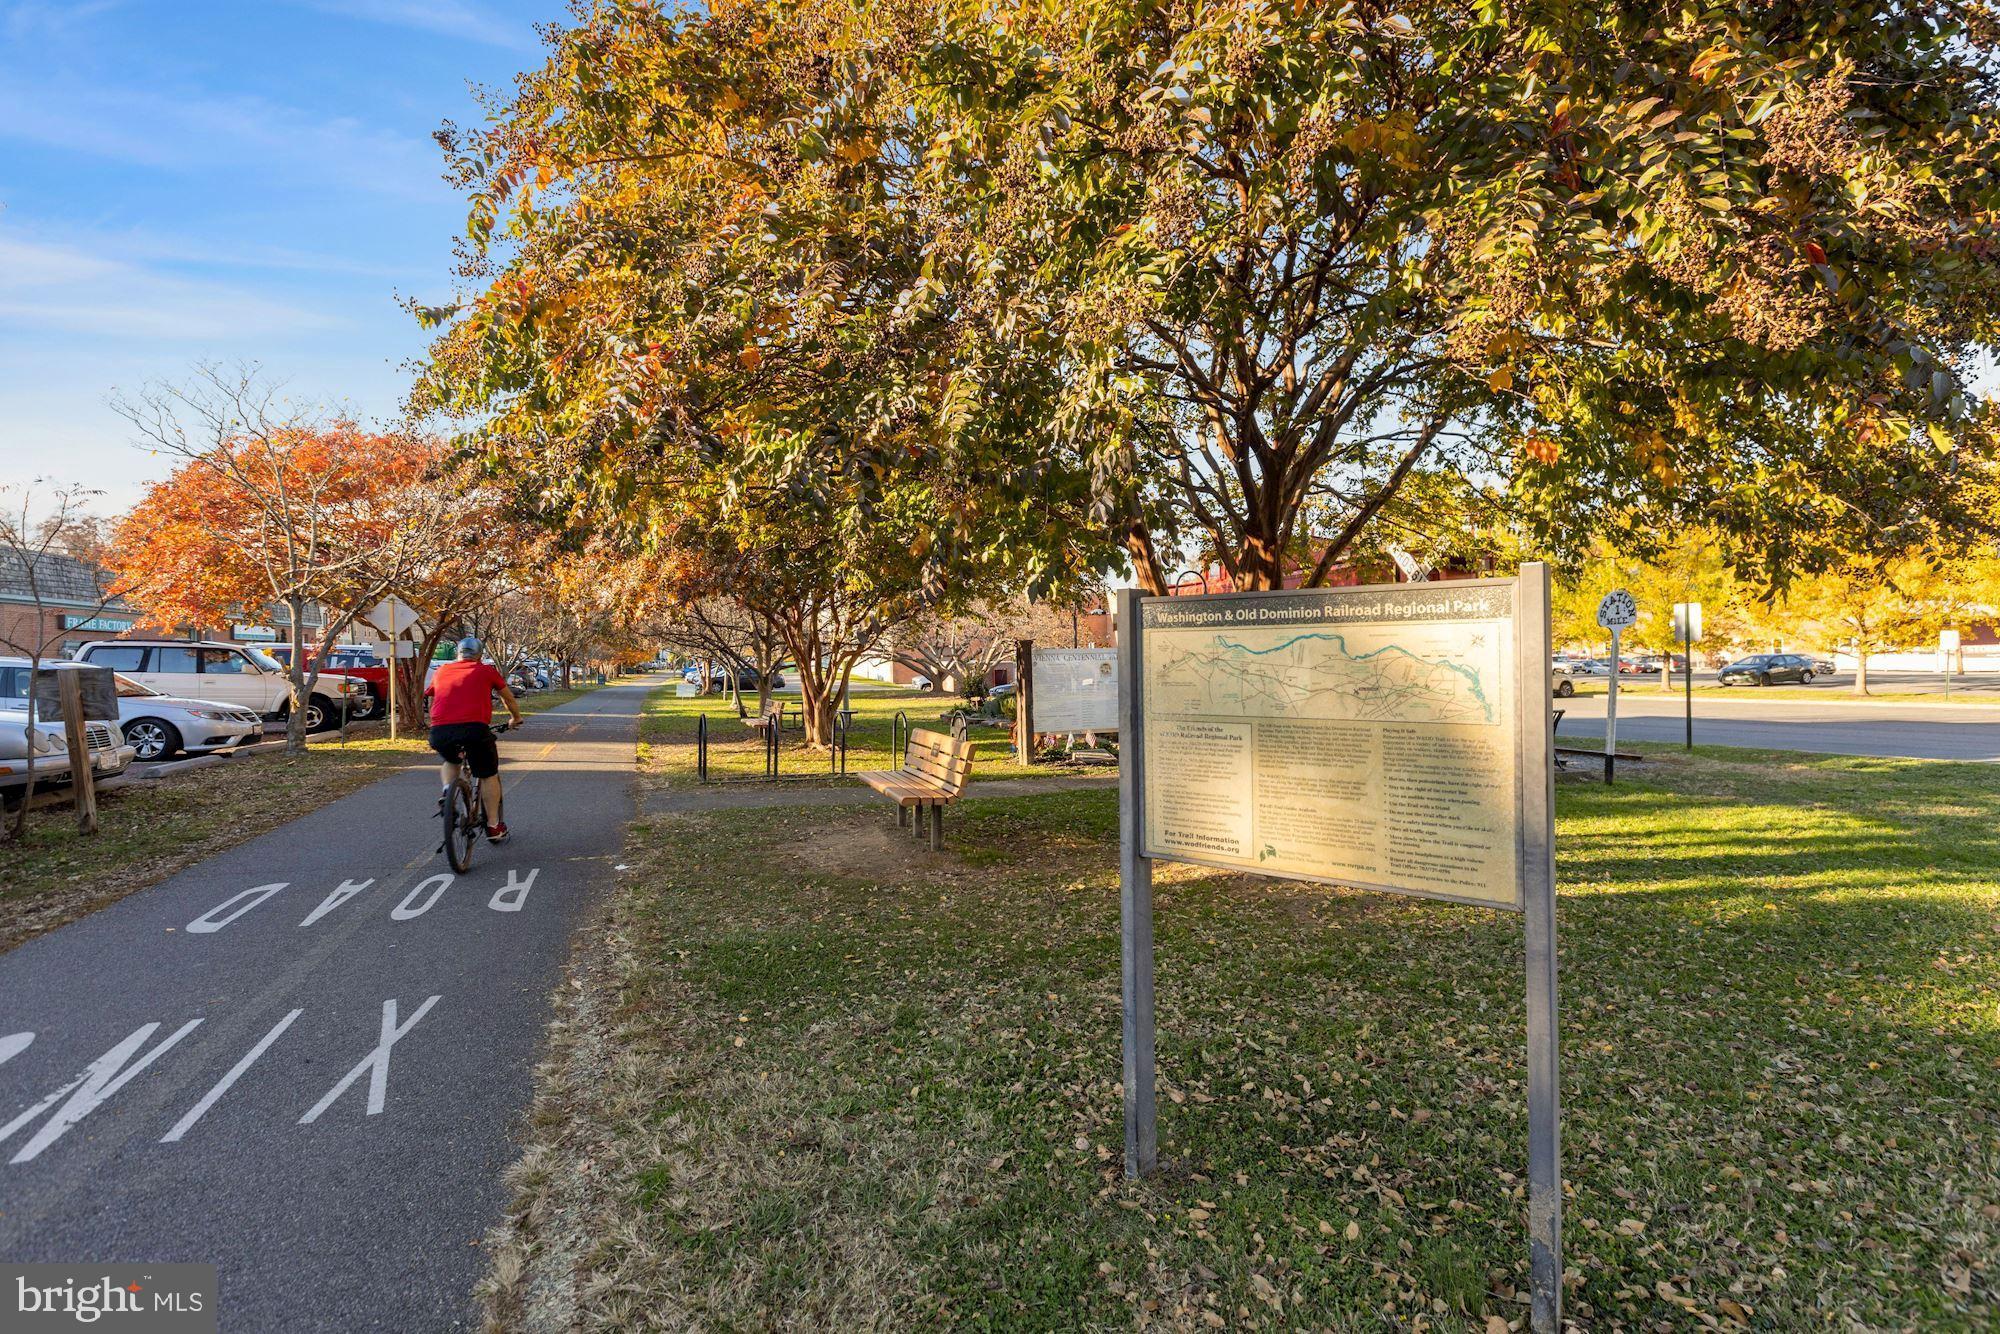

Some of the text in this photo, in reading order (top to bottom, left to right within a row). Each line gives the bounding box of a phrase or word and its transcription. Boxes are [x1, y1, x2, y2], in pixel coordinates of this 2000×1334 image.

[1157, 599, 1489, 624] Washington & Old Dominion Railroad Regional Park
[1600, 593, 1636, 618] STATION
[1616, 605, 1620, 614] 1
[67, 618, 132, 630] FRAME FACTORY
[1165, 839, 1240, 853] www.wodfriends.org
[1196, 835, 1239, 844] Information
[185, 868, 540, 934] ROAD
[0, 995, 442, 1164] XIN
